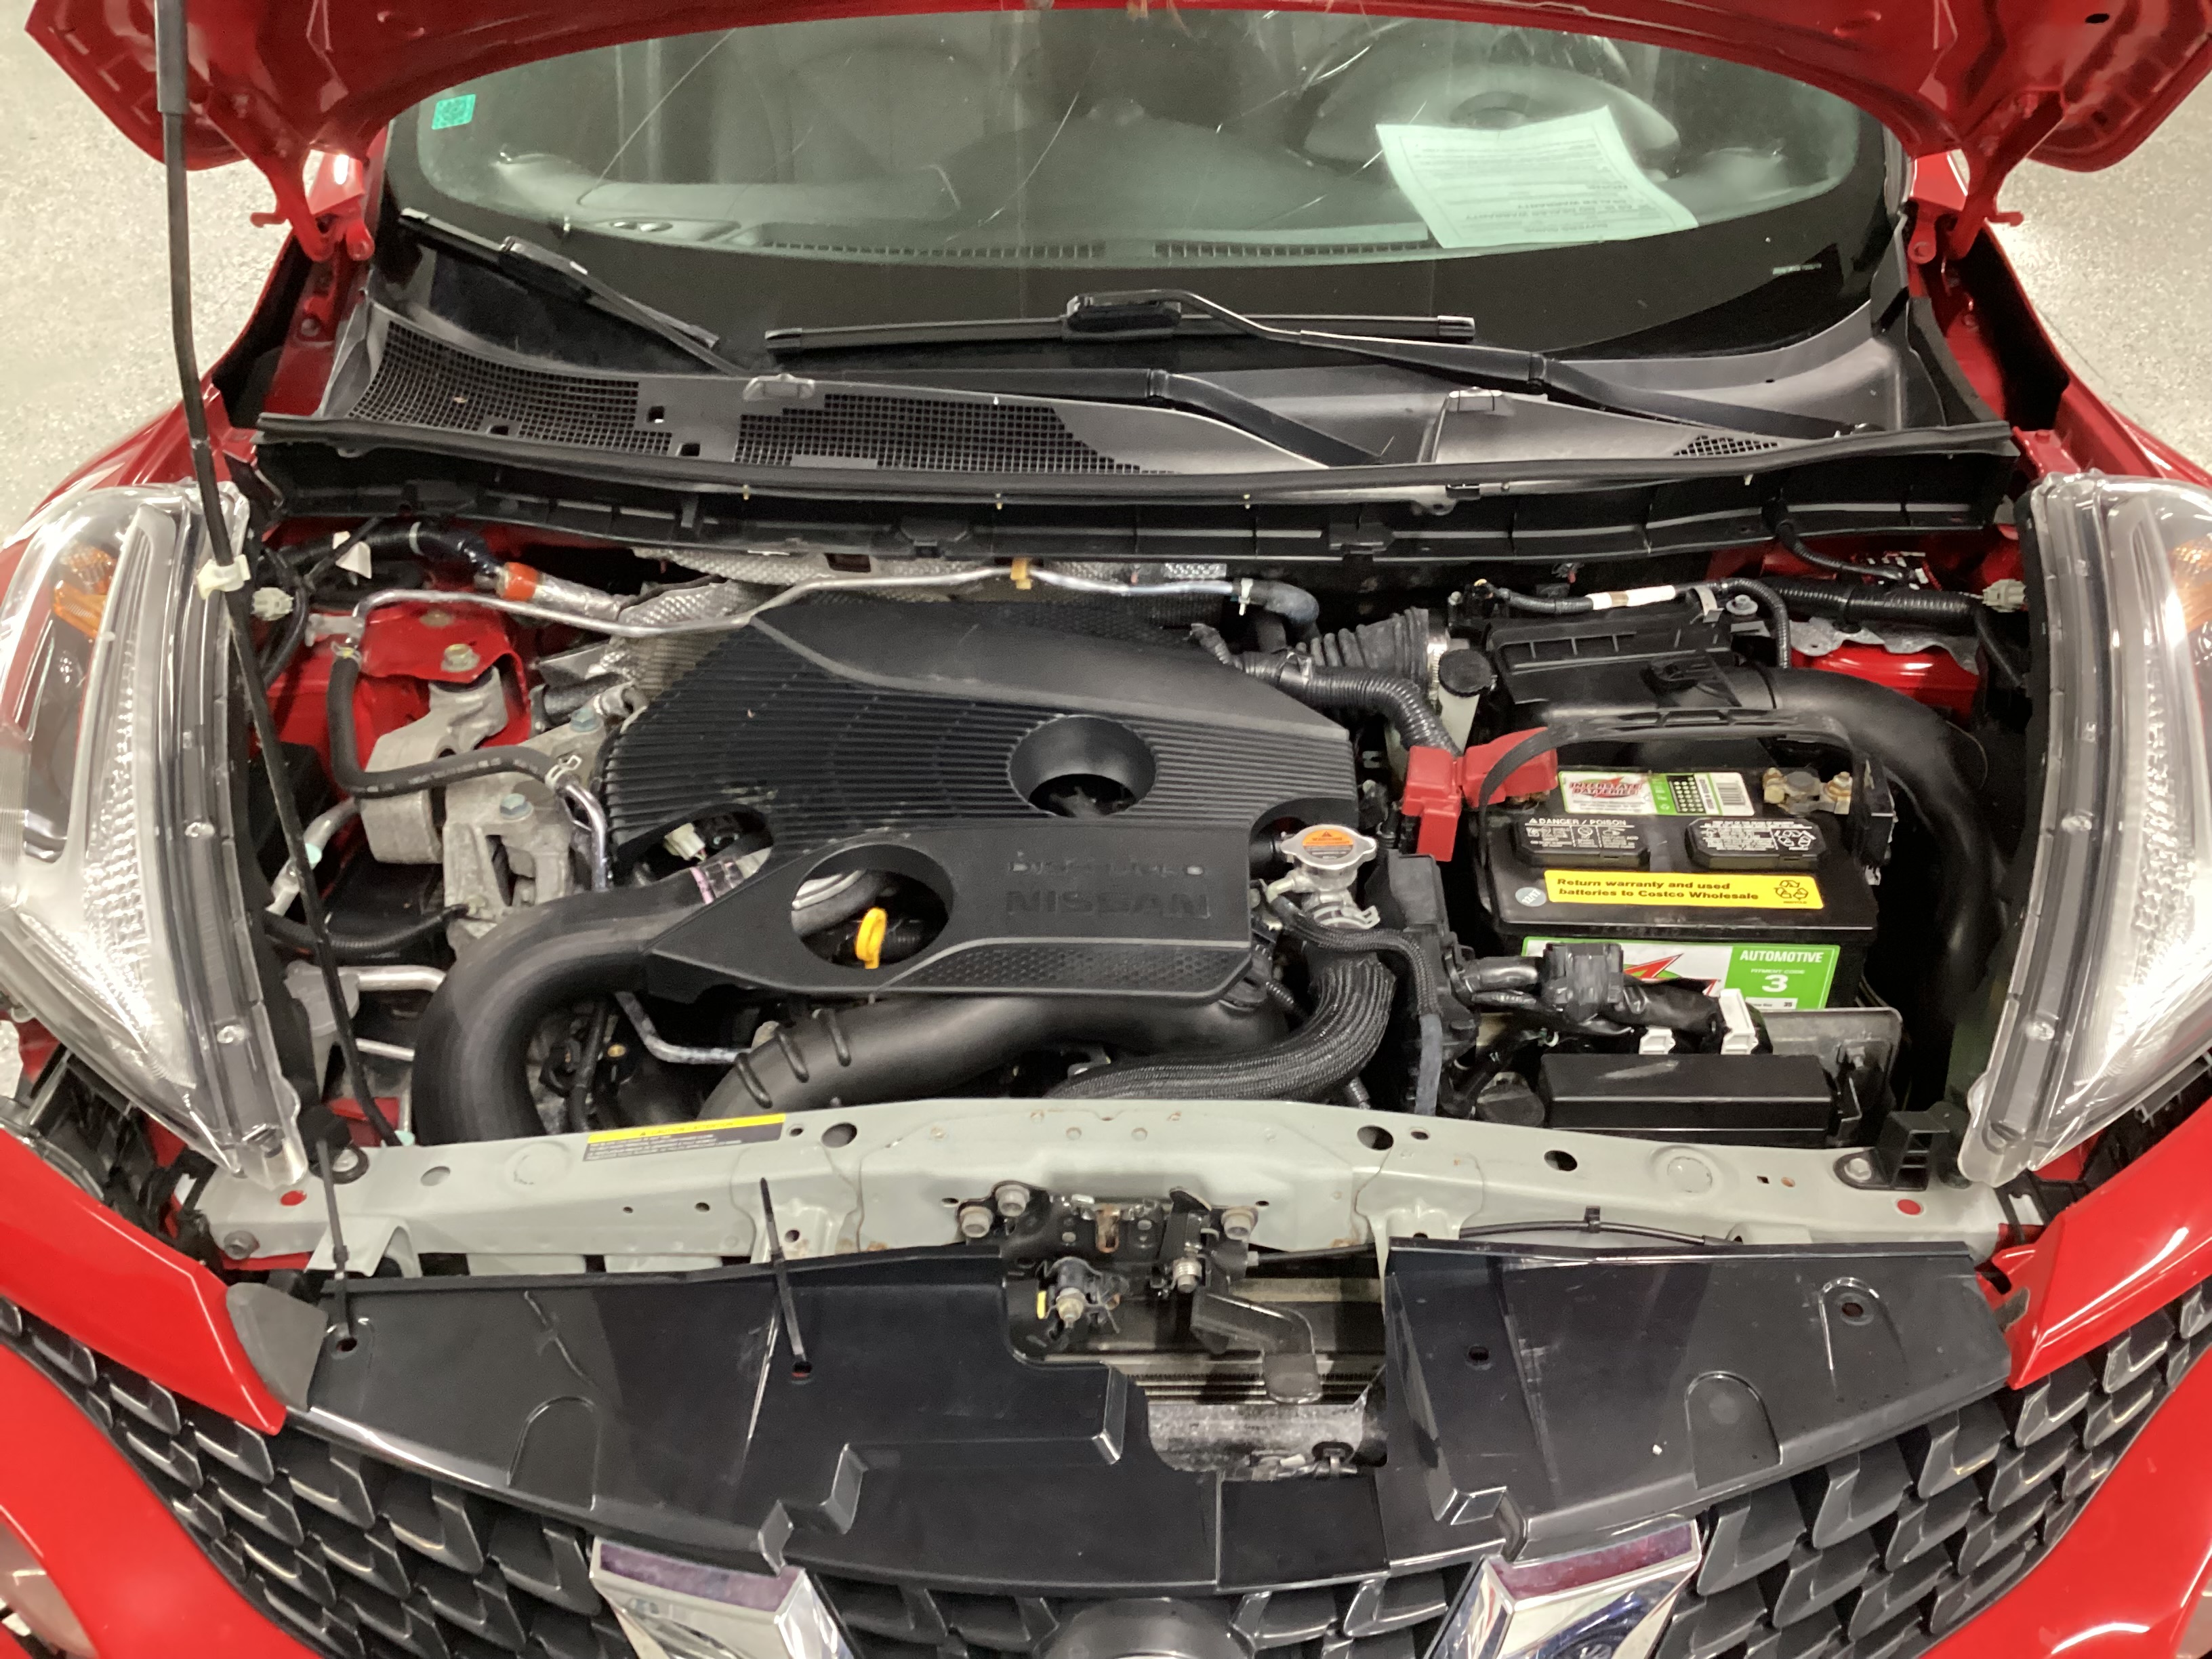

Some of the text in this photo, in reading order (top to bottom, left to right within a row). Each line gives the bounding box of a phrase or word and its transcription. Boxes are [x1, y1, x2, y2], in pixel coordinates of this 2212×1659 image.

[1605, 881, 1664, 889] warranty
[1521, 888, 1541, 904] 12/17
[1689, 891, 1759, 899] Wholesale
[1740, 950, 1824, 963] AUTOMOTIVE
[1762, 975, 1788, 992] 3
